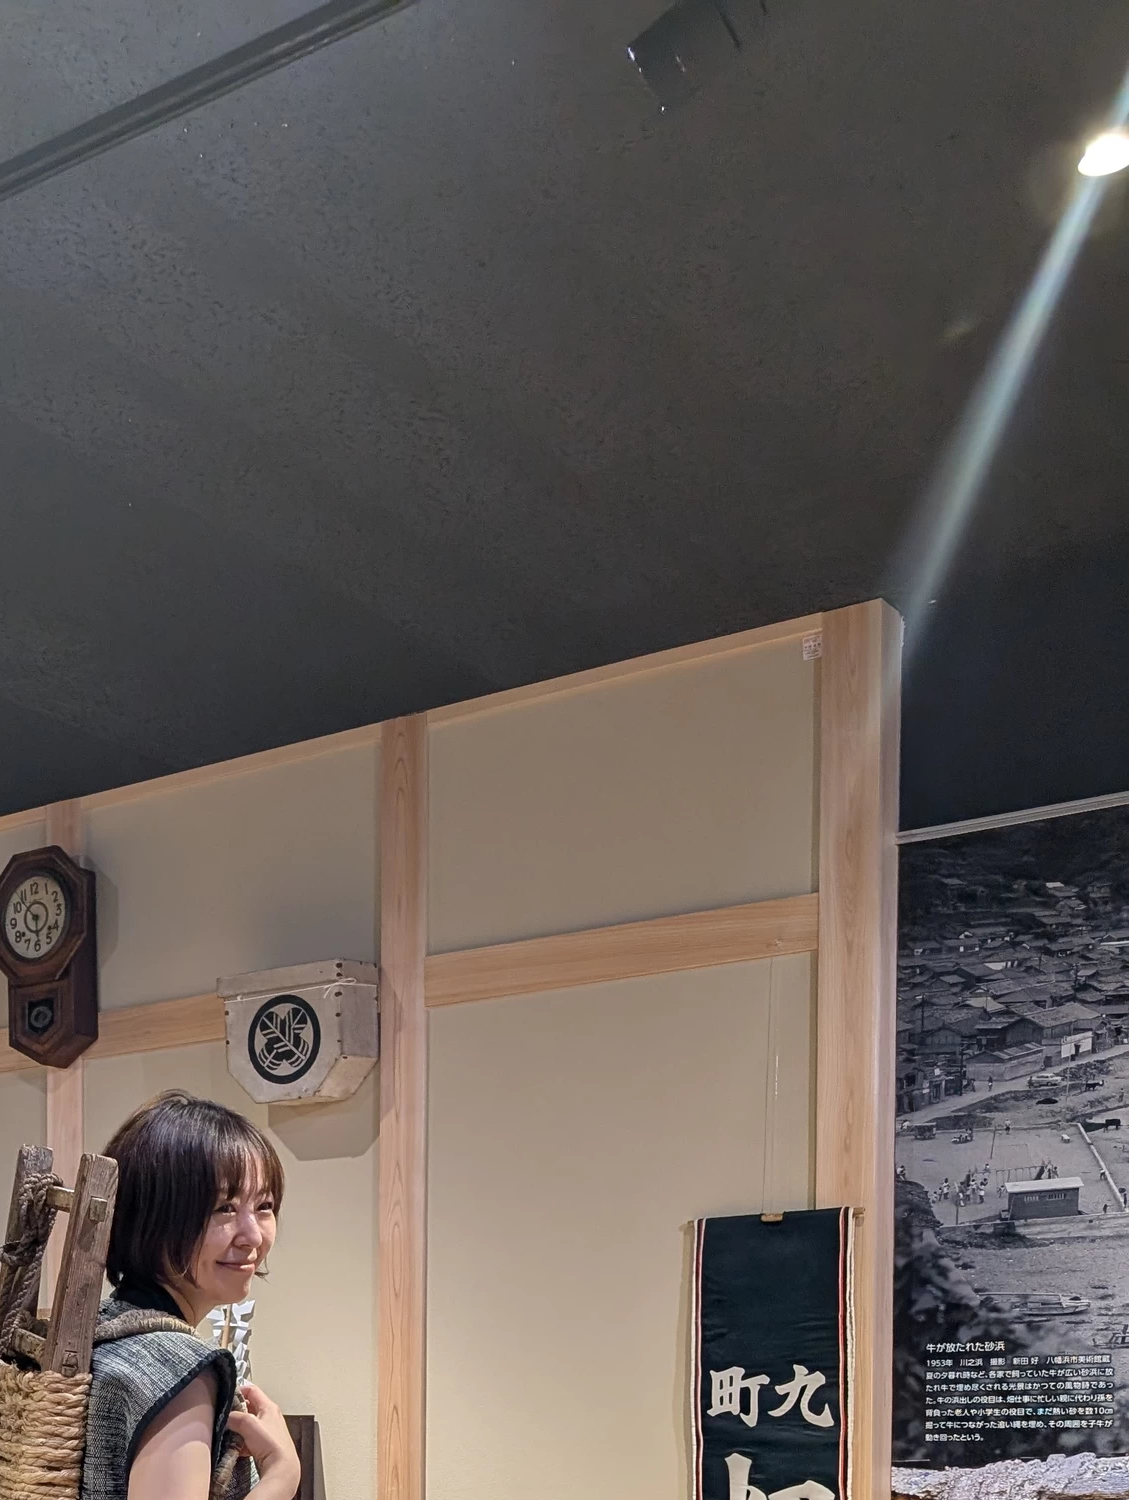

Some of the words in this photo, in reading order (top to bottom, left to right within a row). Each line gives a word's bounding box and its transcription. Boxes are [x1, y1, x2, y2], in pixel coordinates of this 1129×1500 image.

[30, 882, 39, 895] 12
[44, 883, 49, 894] 1
[51, 891, 58, 902] 2
[13, 902, 22, 914] 10
[55, 904, 62, 916] 3
[10, 918, 17, 929] 9
[52, 919, 59, 931] 4
[14, 930, 21, 943] 8
[45, 932, 52, 944] 5
[24, 939, 31, 951] 7
[34, 939, 41, 952] 6
[926, 1341, 1006, 1353] 牛が放たれた砂浜
[926, 1358, 953, 1367] 1953年
[960, 1358, 983, 1367] 川之浜
[990, 1357, 1006, 1366] 撮影
[1013, 1356, 1028, 1365] 新田
[1030, 1356, 1039, 1365] 好
[1046, 1354, 1111, 1365] 八幡浜市美術館蔵
[925, 1368, 1114, 1380] 夏の夕暮れ時など、各家で飼っていた牛が広い砂浜に放
[925, 1381, 1114, 1393] たれ牛で埋め尽くされる光景はかつての風物詩であっ
[925, 1433, 985, 1442] 動き回ったという。
